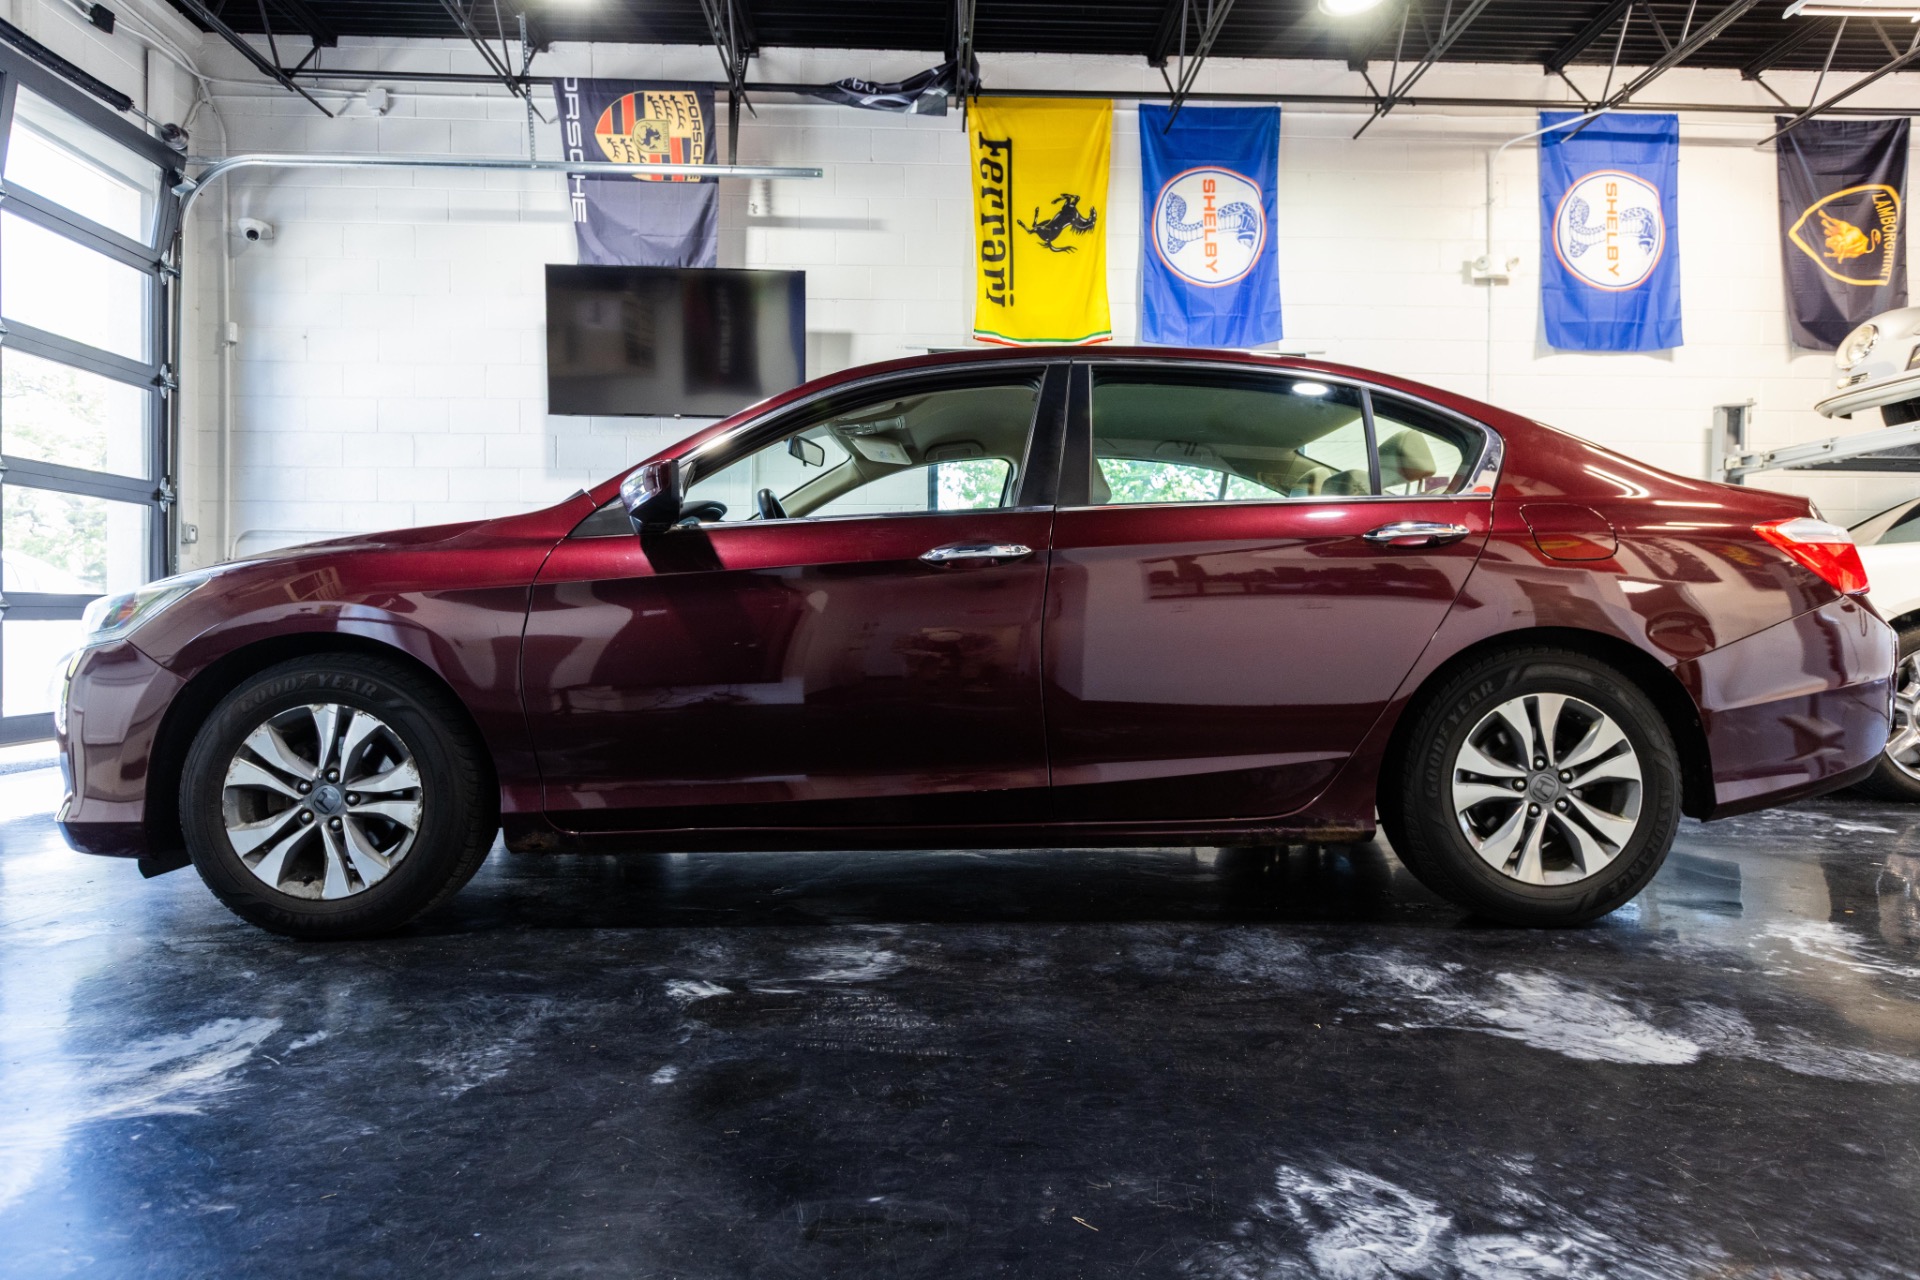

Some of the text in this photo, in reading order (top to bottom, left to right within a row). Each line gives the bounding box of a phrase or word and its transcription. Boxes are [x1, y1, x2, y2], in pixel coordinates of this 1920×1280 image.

[564, 77, 587, 223] ORSCHE
[978, 131, 1014, 308] Ferrari
[1203, 178, 1218, 274] SHELBY
[1605, 182, 1620, 277] SHELBY
[1872, 193, 1897, 277] LAMBORGHINI
